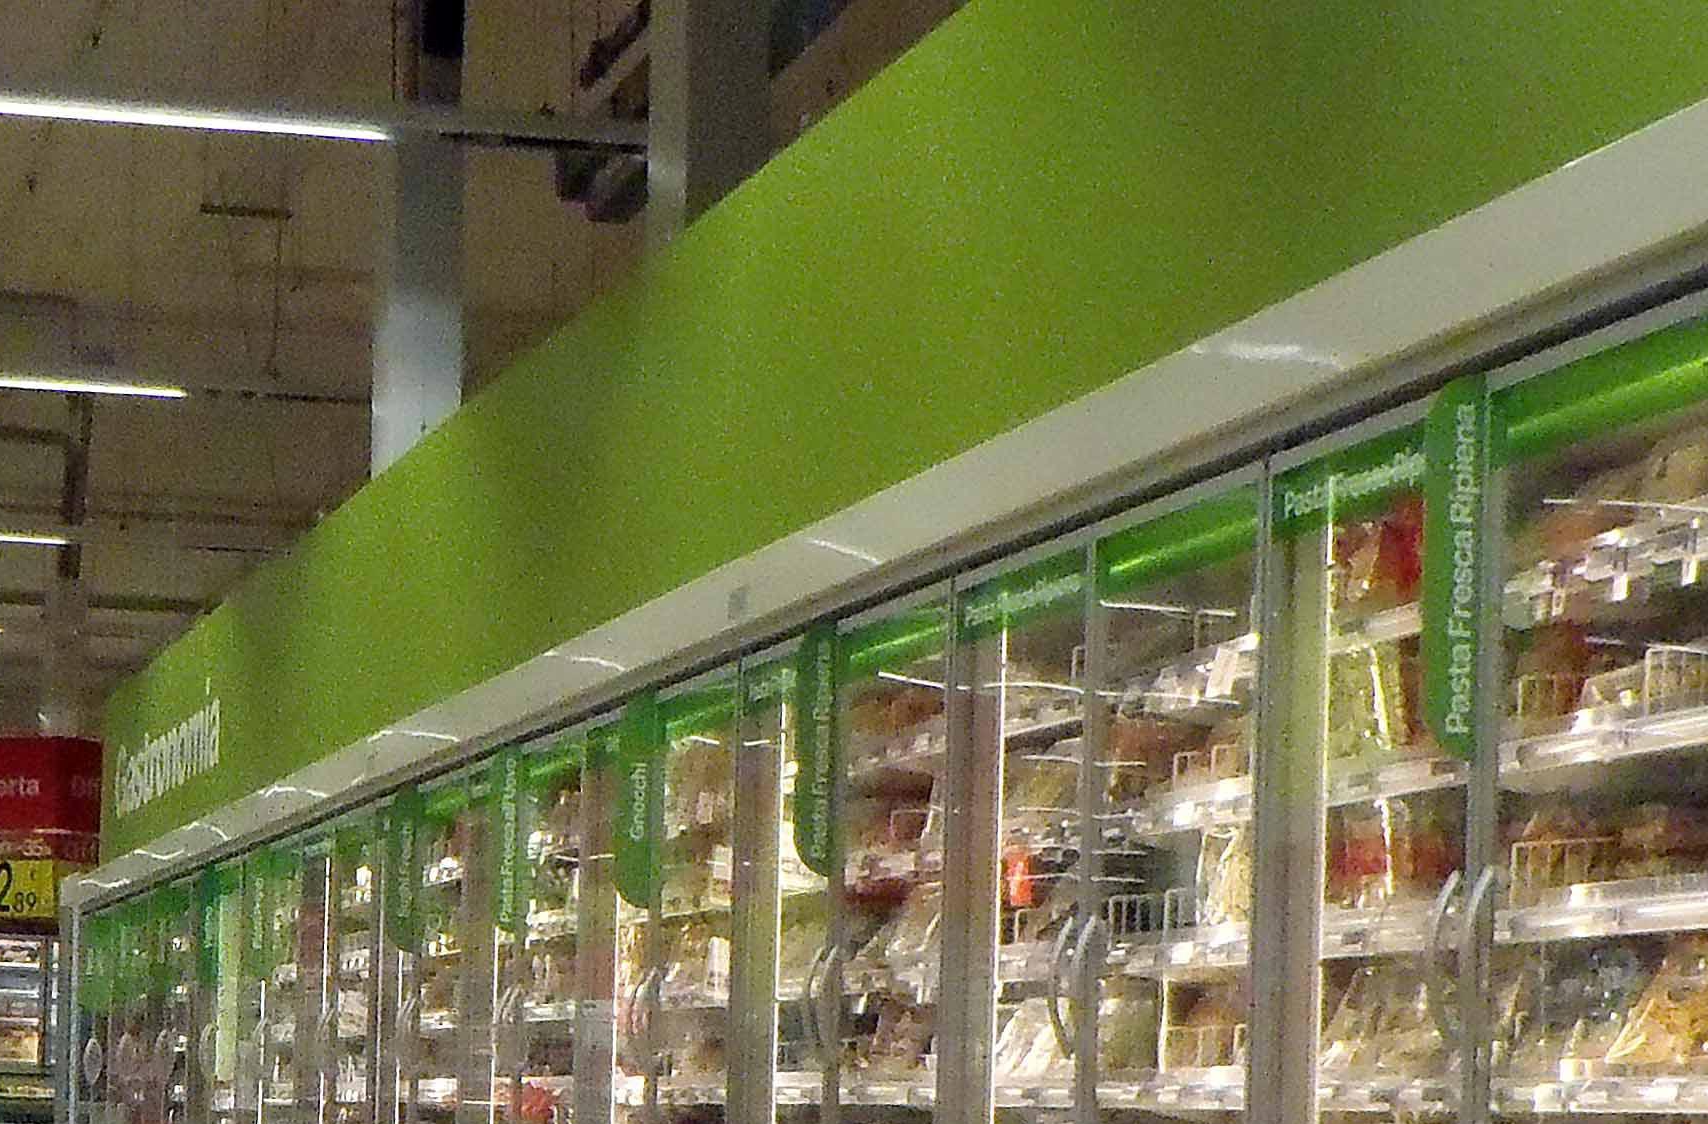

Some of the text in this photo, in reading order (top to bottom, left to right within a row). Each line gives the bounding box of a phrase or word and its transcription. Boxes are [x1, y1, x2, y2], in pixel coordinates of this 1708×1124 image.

[1444, 403, 1480, 735] Pasta Fresca Ripiena
[114, 677, 222, 819] Gastronomia
[629, 762, 647, 842] Gnocchi
